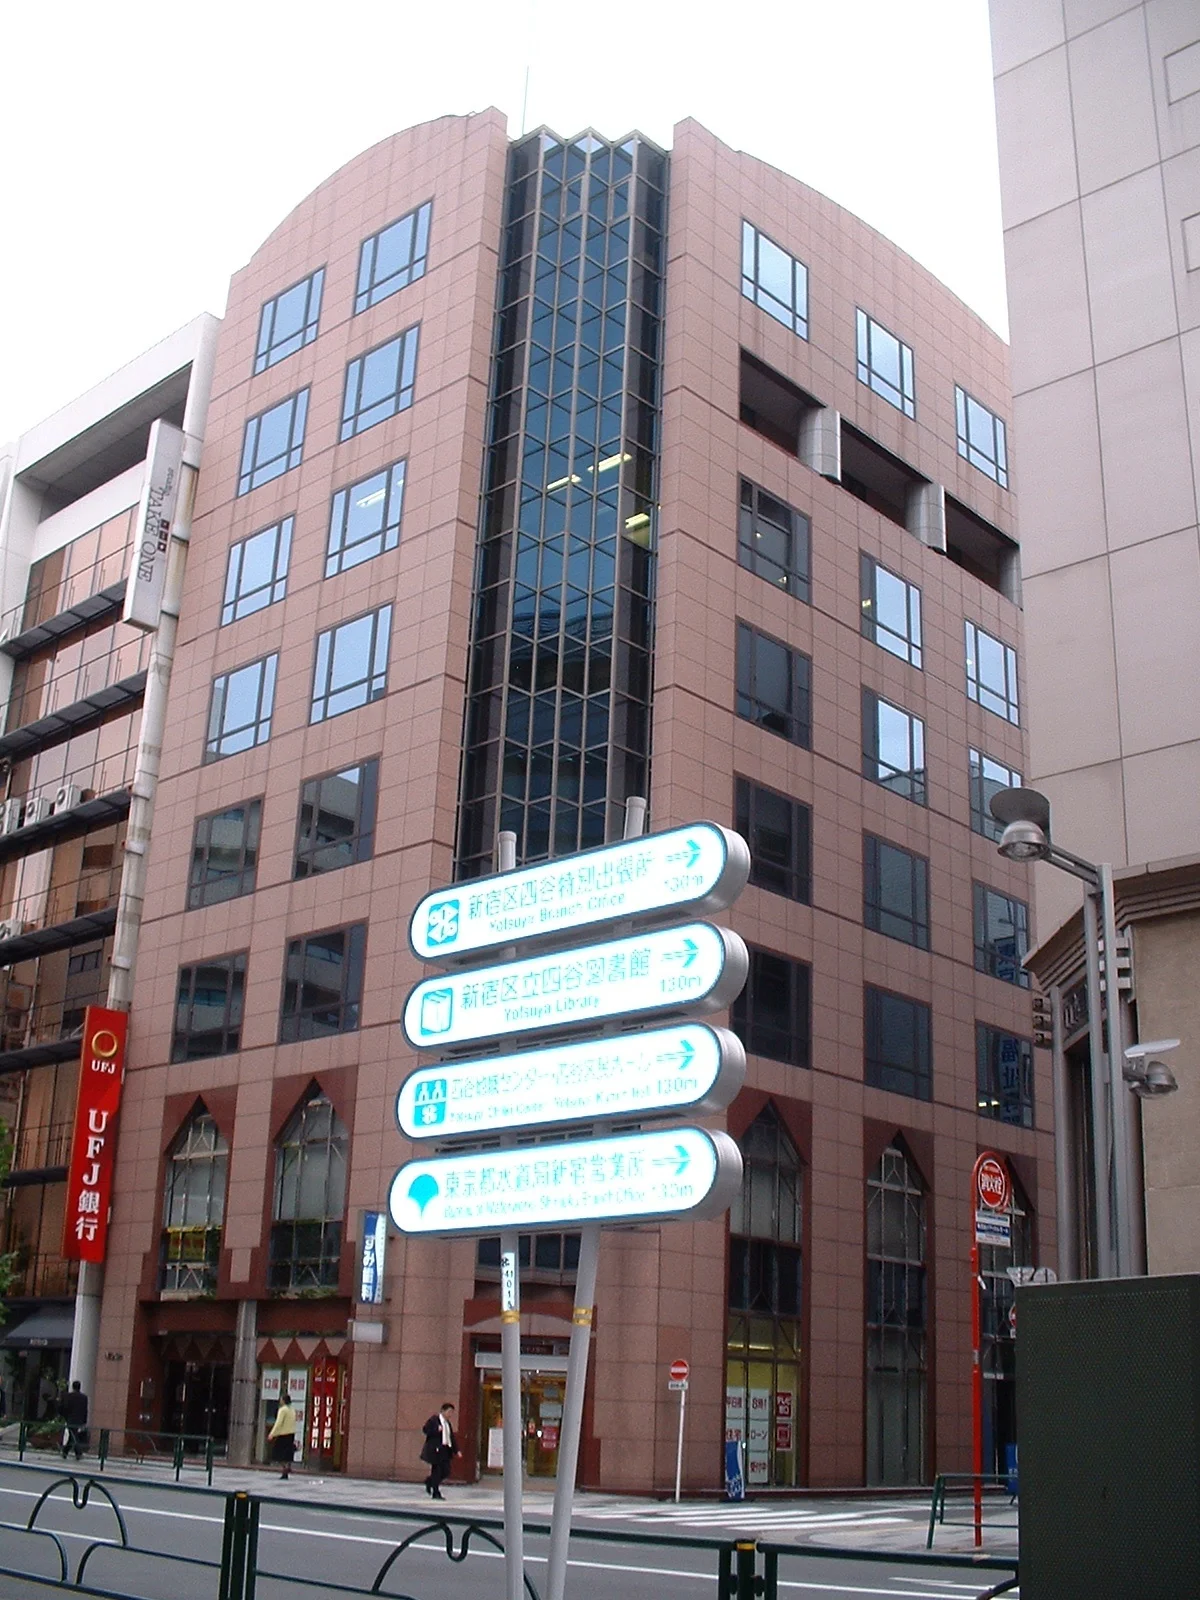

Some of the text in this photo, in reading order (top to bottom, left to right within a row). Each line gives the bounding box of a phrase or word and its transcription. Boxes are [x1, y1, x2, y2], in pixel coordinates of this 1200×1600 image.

[138, 487, 164, 582] TAKE ONE
[461, 948, 652, 1010] 新宿区立四谷図書館
[660, 975, 702, 993] 130m
[504, 995, 601, 1023] Yotsuya Library
[91, 1059, 116, 1074] UFJ
[656, 1077, 698, 1095] 130m
[75, 1107, 109, 1241] UFJ銀行
